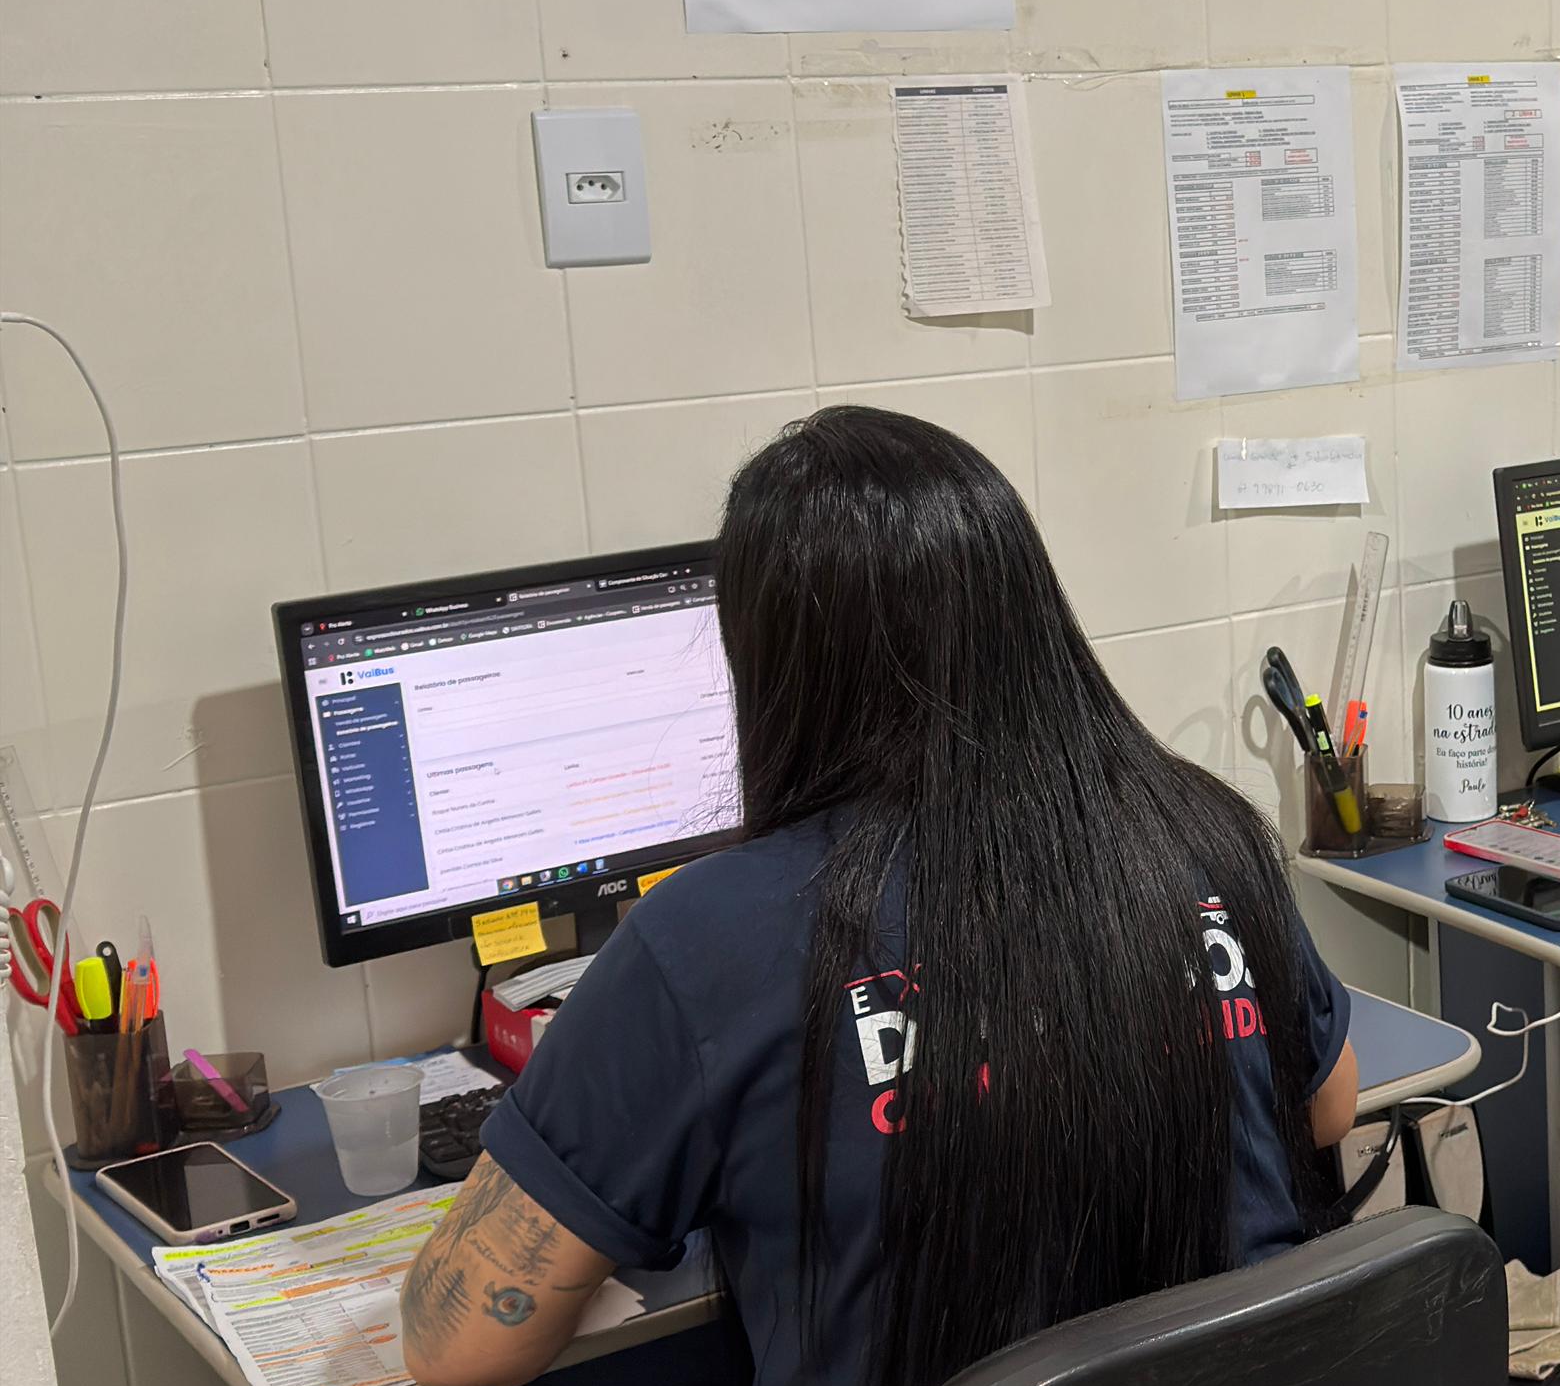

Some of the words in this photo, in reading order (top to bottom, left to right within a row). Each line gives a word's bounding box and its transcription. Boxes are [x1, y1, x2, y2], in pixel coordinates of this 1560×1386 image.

[446, 677, 457, 687] de
[1447, 703, 1464, 721] 10
[1467, 706, 1493, 720] anos
[1433, 726, 1451, 739] na
[1436, 747, 1447, 757] Eu
[1448, 748, 1466, 759] faço
[1467, 748, 1486, 759] parte
[597, 878, 628, 898] AOC
